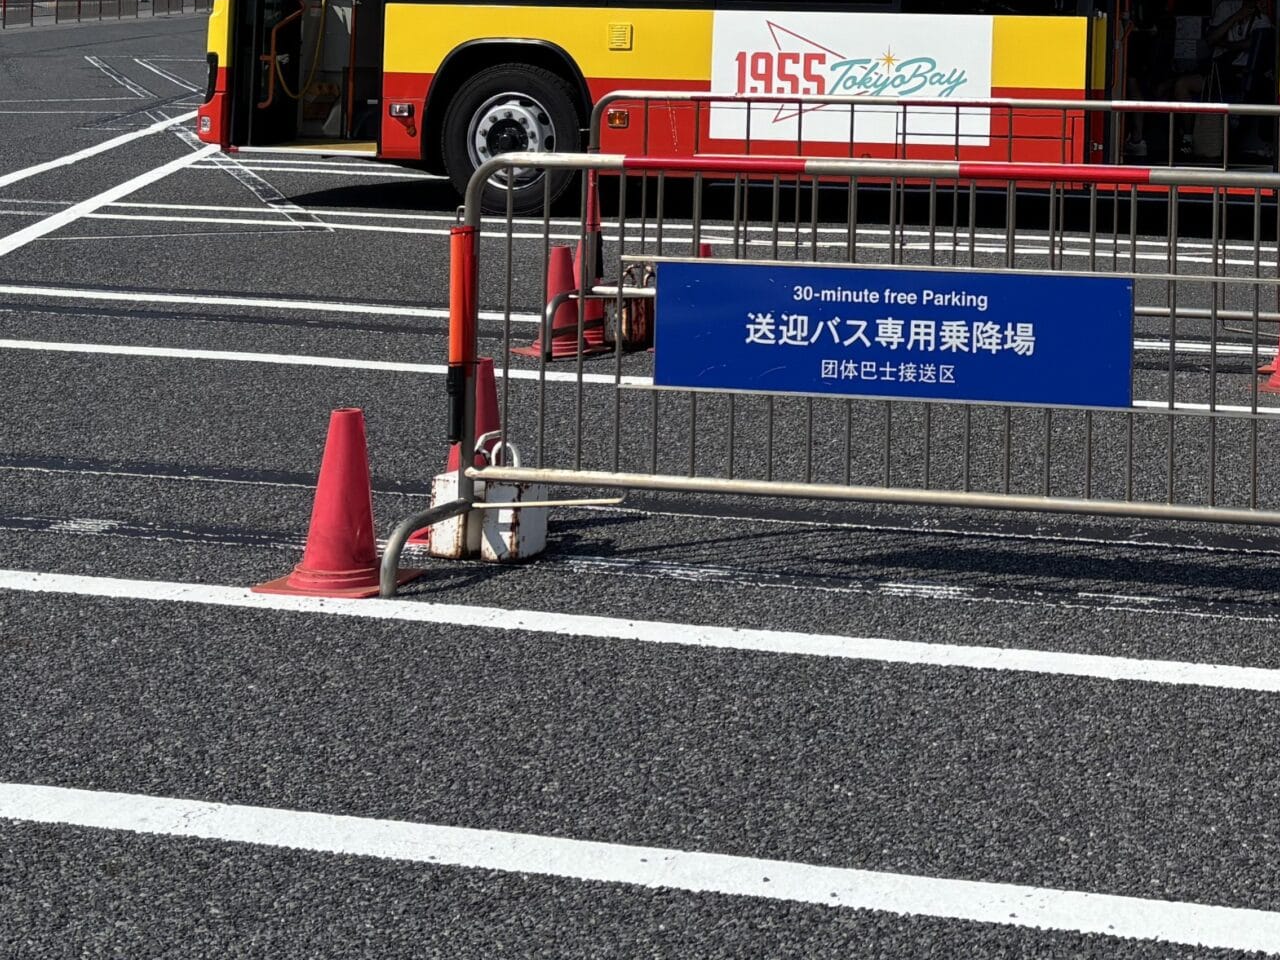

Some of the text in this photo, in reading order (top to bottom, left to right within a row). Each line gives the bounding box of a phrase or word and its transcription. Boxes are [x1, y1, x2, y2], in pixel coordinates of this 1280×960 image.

[735, 51, 826, 96] 1955
[793, 286, 988, 310] 30-minute free Parking
[745, 312, 1037, 356] 送迎バス専用乗降場
[821, 360, 956, 384] 团体巴士接送区
